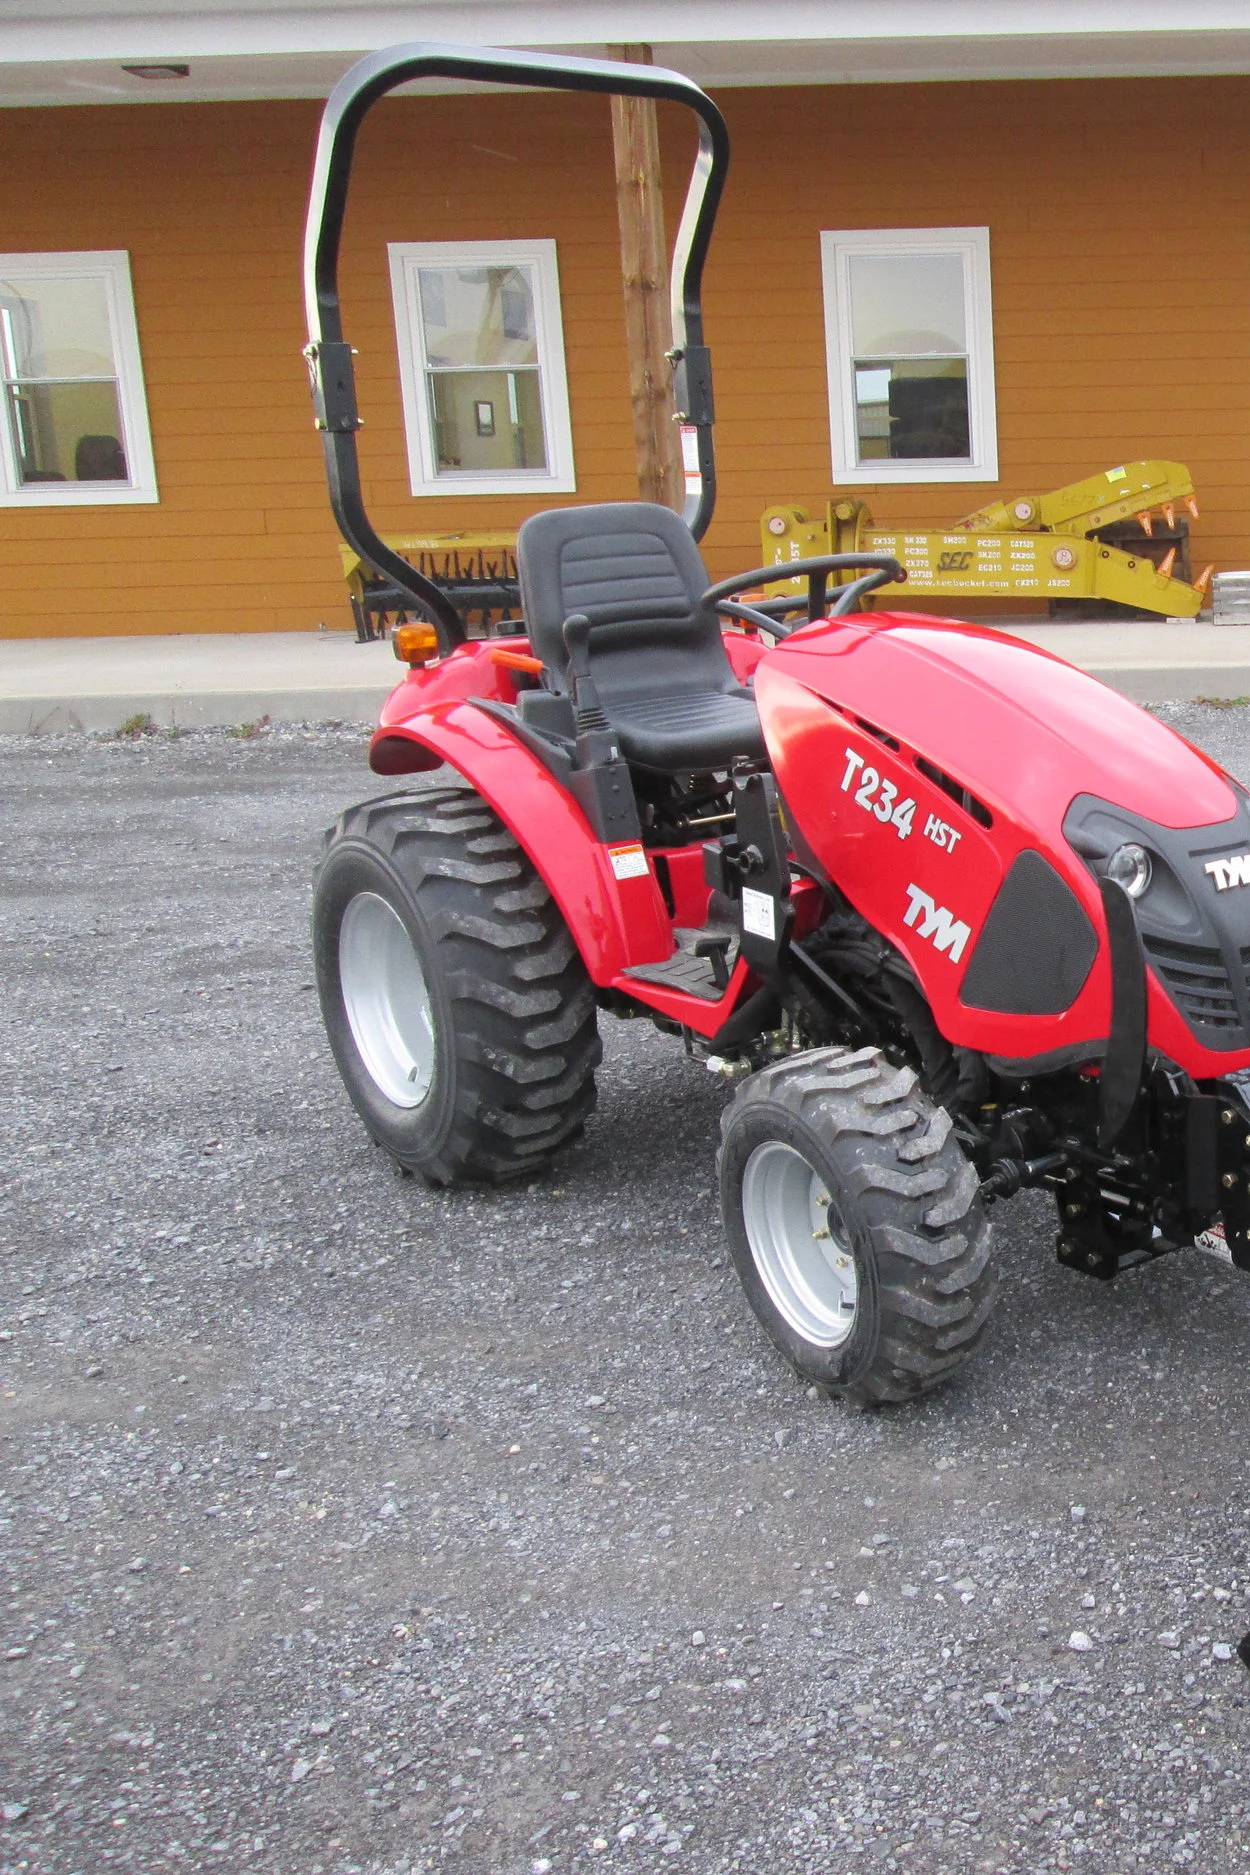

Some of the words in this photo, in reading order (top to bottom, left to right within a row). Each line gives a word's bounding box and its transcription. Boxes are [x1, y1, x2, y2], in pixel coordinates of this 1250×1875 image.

[977, 539, 1001, 547] PC200
[1010, 540, 1034, 548] CAT320
[905, 559, 929, 567] ZX270
[937, 551, 974, 571] SEC
[840, 747, 918, 840] T234
[923, 813, 962, 854] HST
[902, 882, 972, 965] TYM
